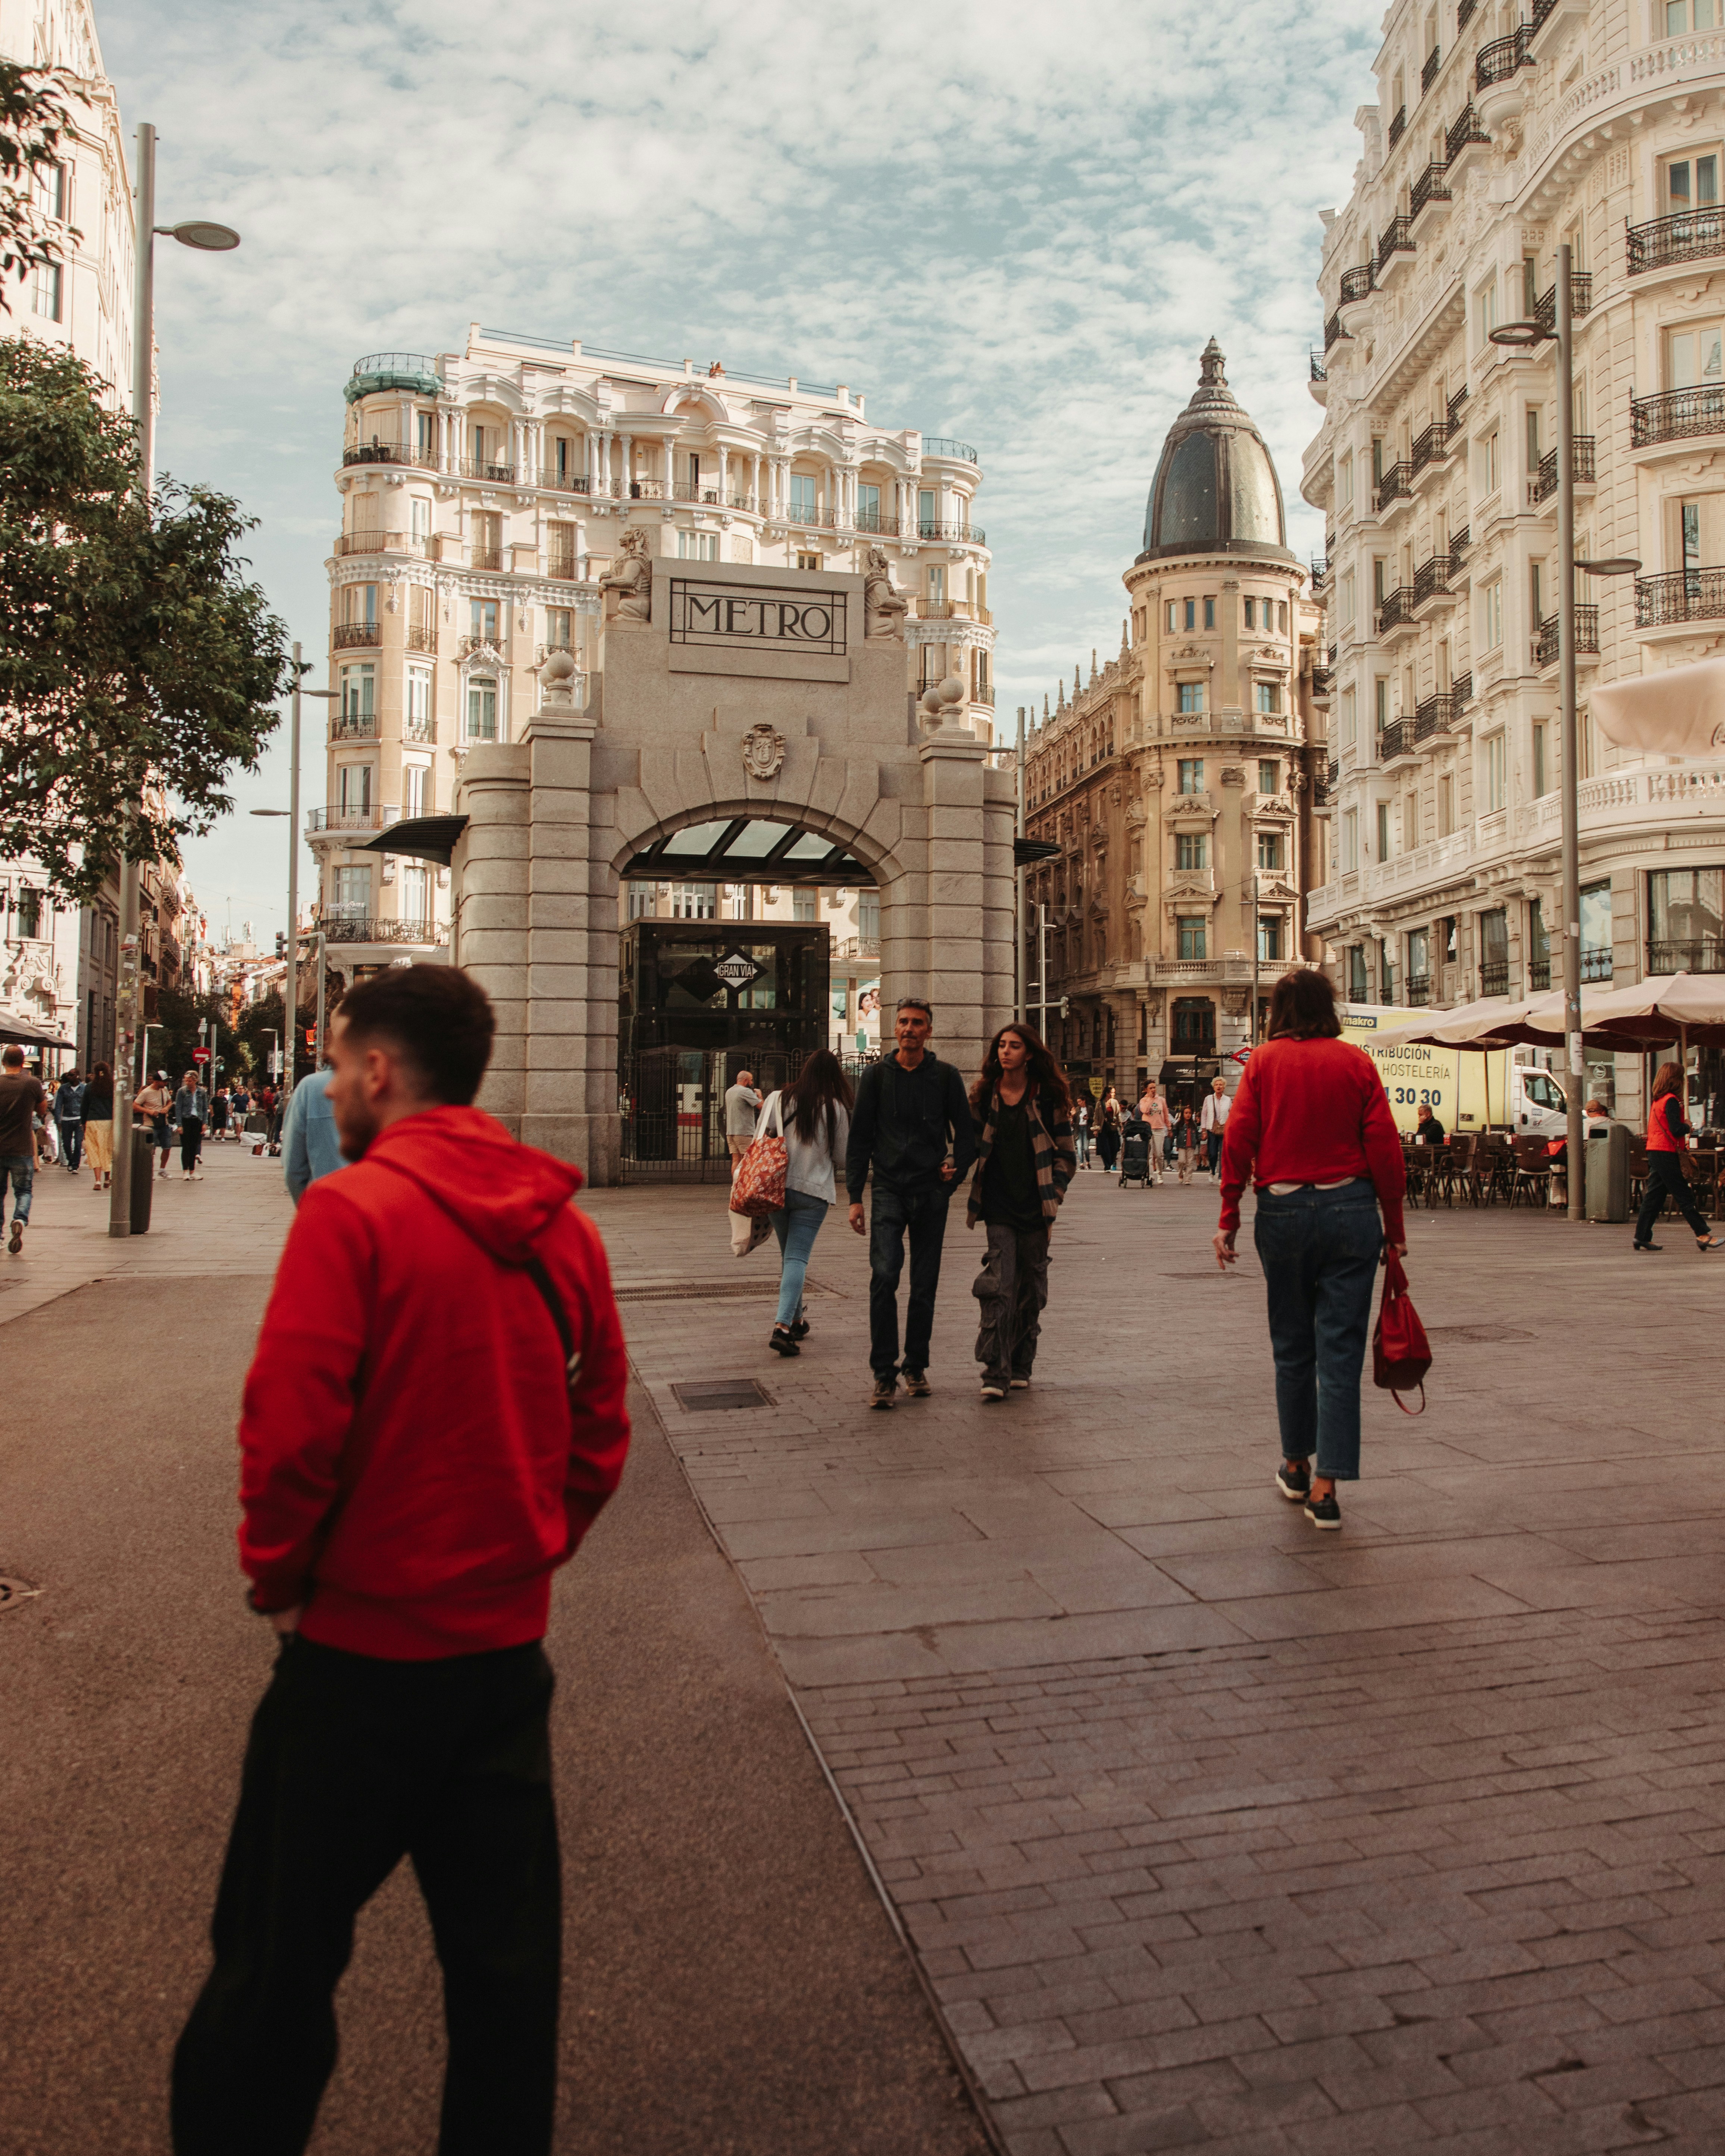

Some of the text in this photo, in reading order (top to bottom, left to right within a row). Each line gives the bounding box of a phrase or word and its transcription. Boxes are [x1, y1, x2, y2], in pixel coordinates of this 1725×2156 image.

[687, 597, 830, 639] METRO
[719, 965, 739, 977] GRAN
[1343, 1016, 1374, 1027] makro
[1383, 1063, 1451, 1079] HOSTELERÍA
[1395, 1087, 1415, 1104] 30
[1421, 1089, 1441, 1106] 30
